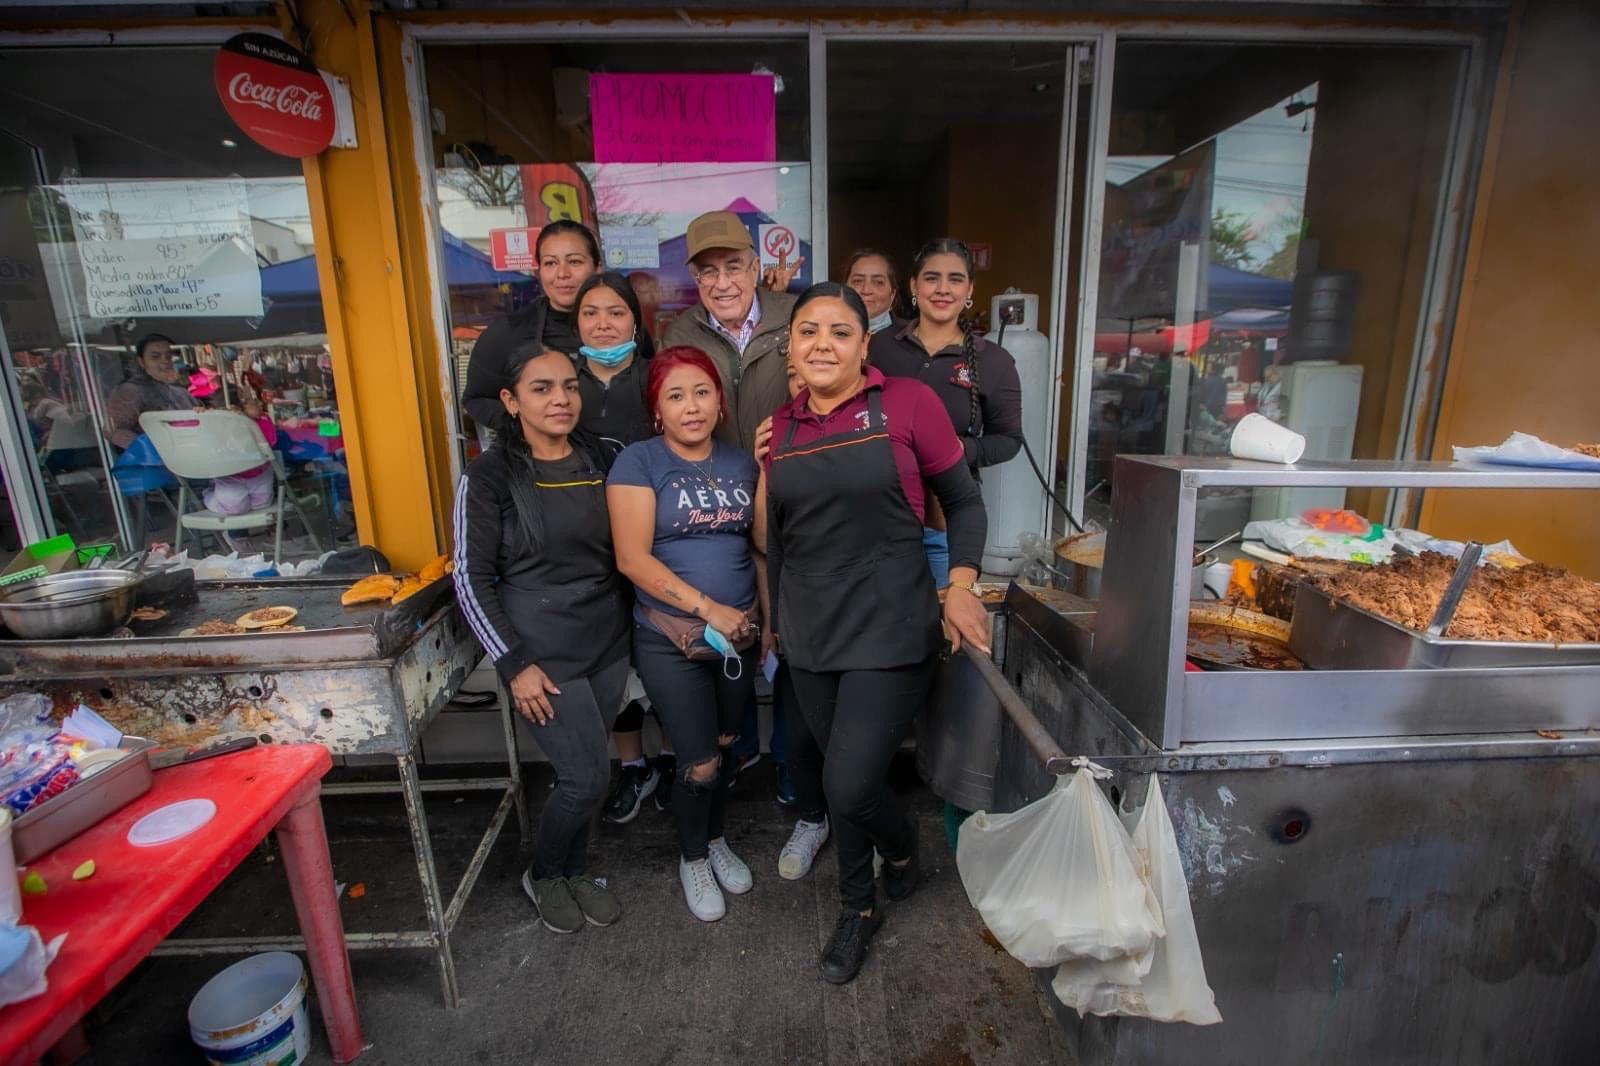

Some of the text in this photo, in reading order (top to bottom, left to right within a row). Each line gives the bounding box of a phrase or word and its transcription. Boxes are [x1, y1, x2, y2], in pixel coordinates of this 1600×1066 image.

[243, 42, 260, 53] SIN
[228, 72, 324, 121] Coca-Cola
[86, 265, 131, 284] Media
[90, 282, 152, 300] Quesadilla
[94, 297, 158, 315] Quesadilla
[677, 487, 751, 510] AERO
[688, 507, 744, 529] New York
